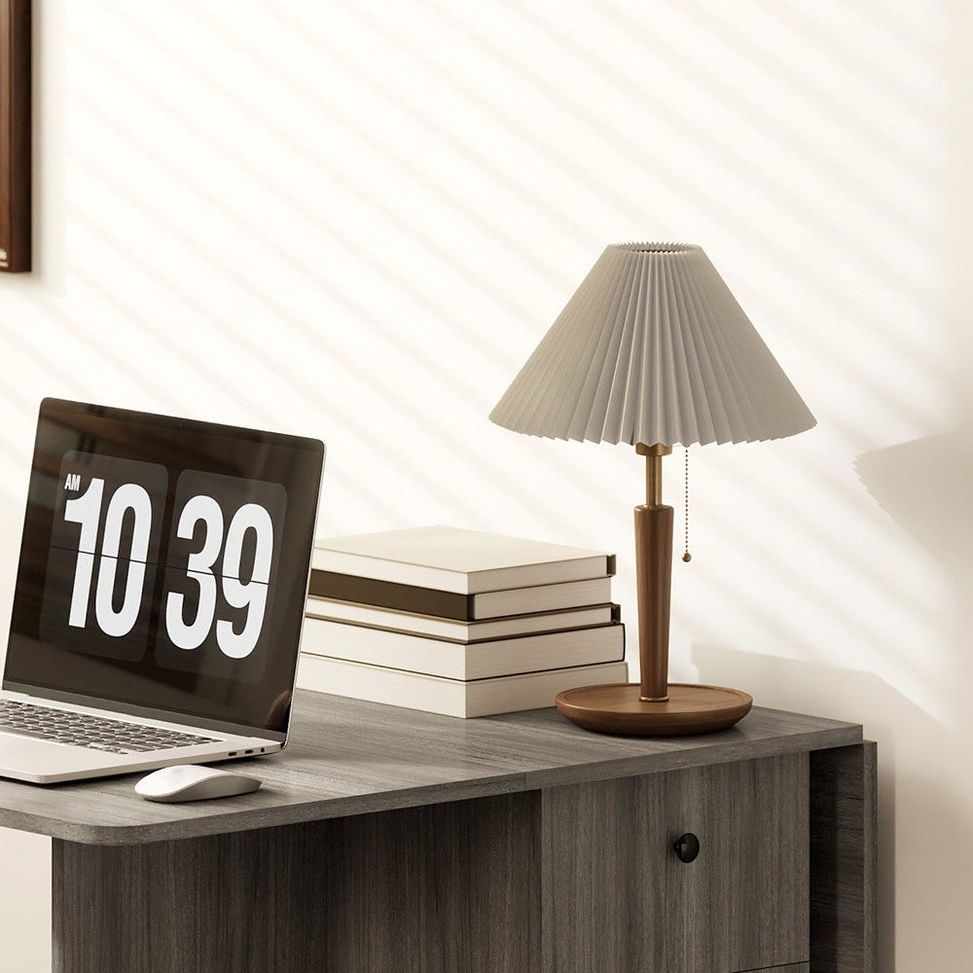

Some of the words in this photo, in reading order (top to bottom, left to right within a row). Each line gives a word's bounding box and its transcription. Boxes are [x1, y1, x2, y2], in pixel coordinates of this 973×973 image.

[64, 473, 81, 492] AM
[64, 477, 153, 638] 10
[165, 495, 274, 659] 39
